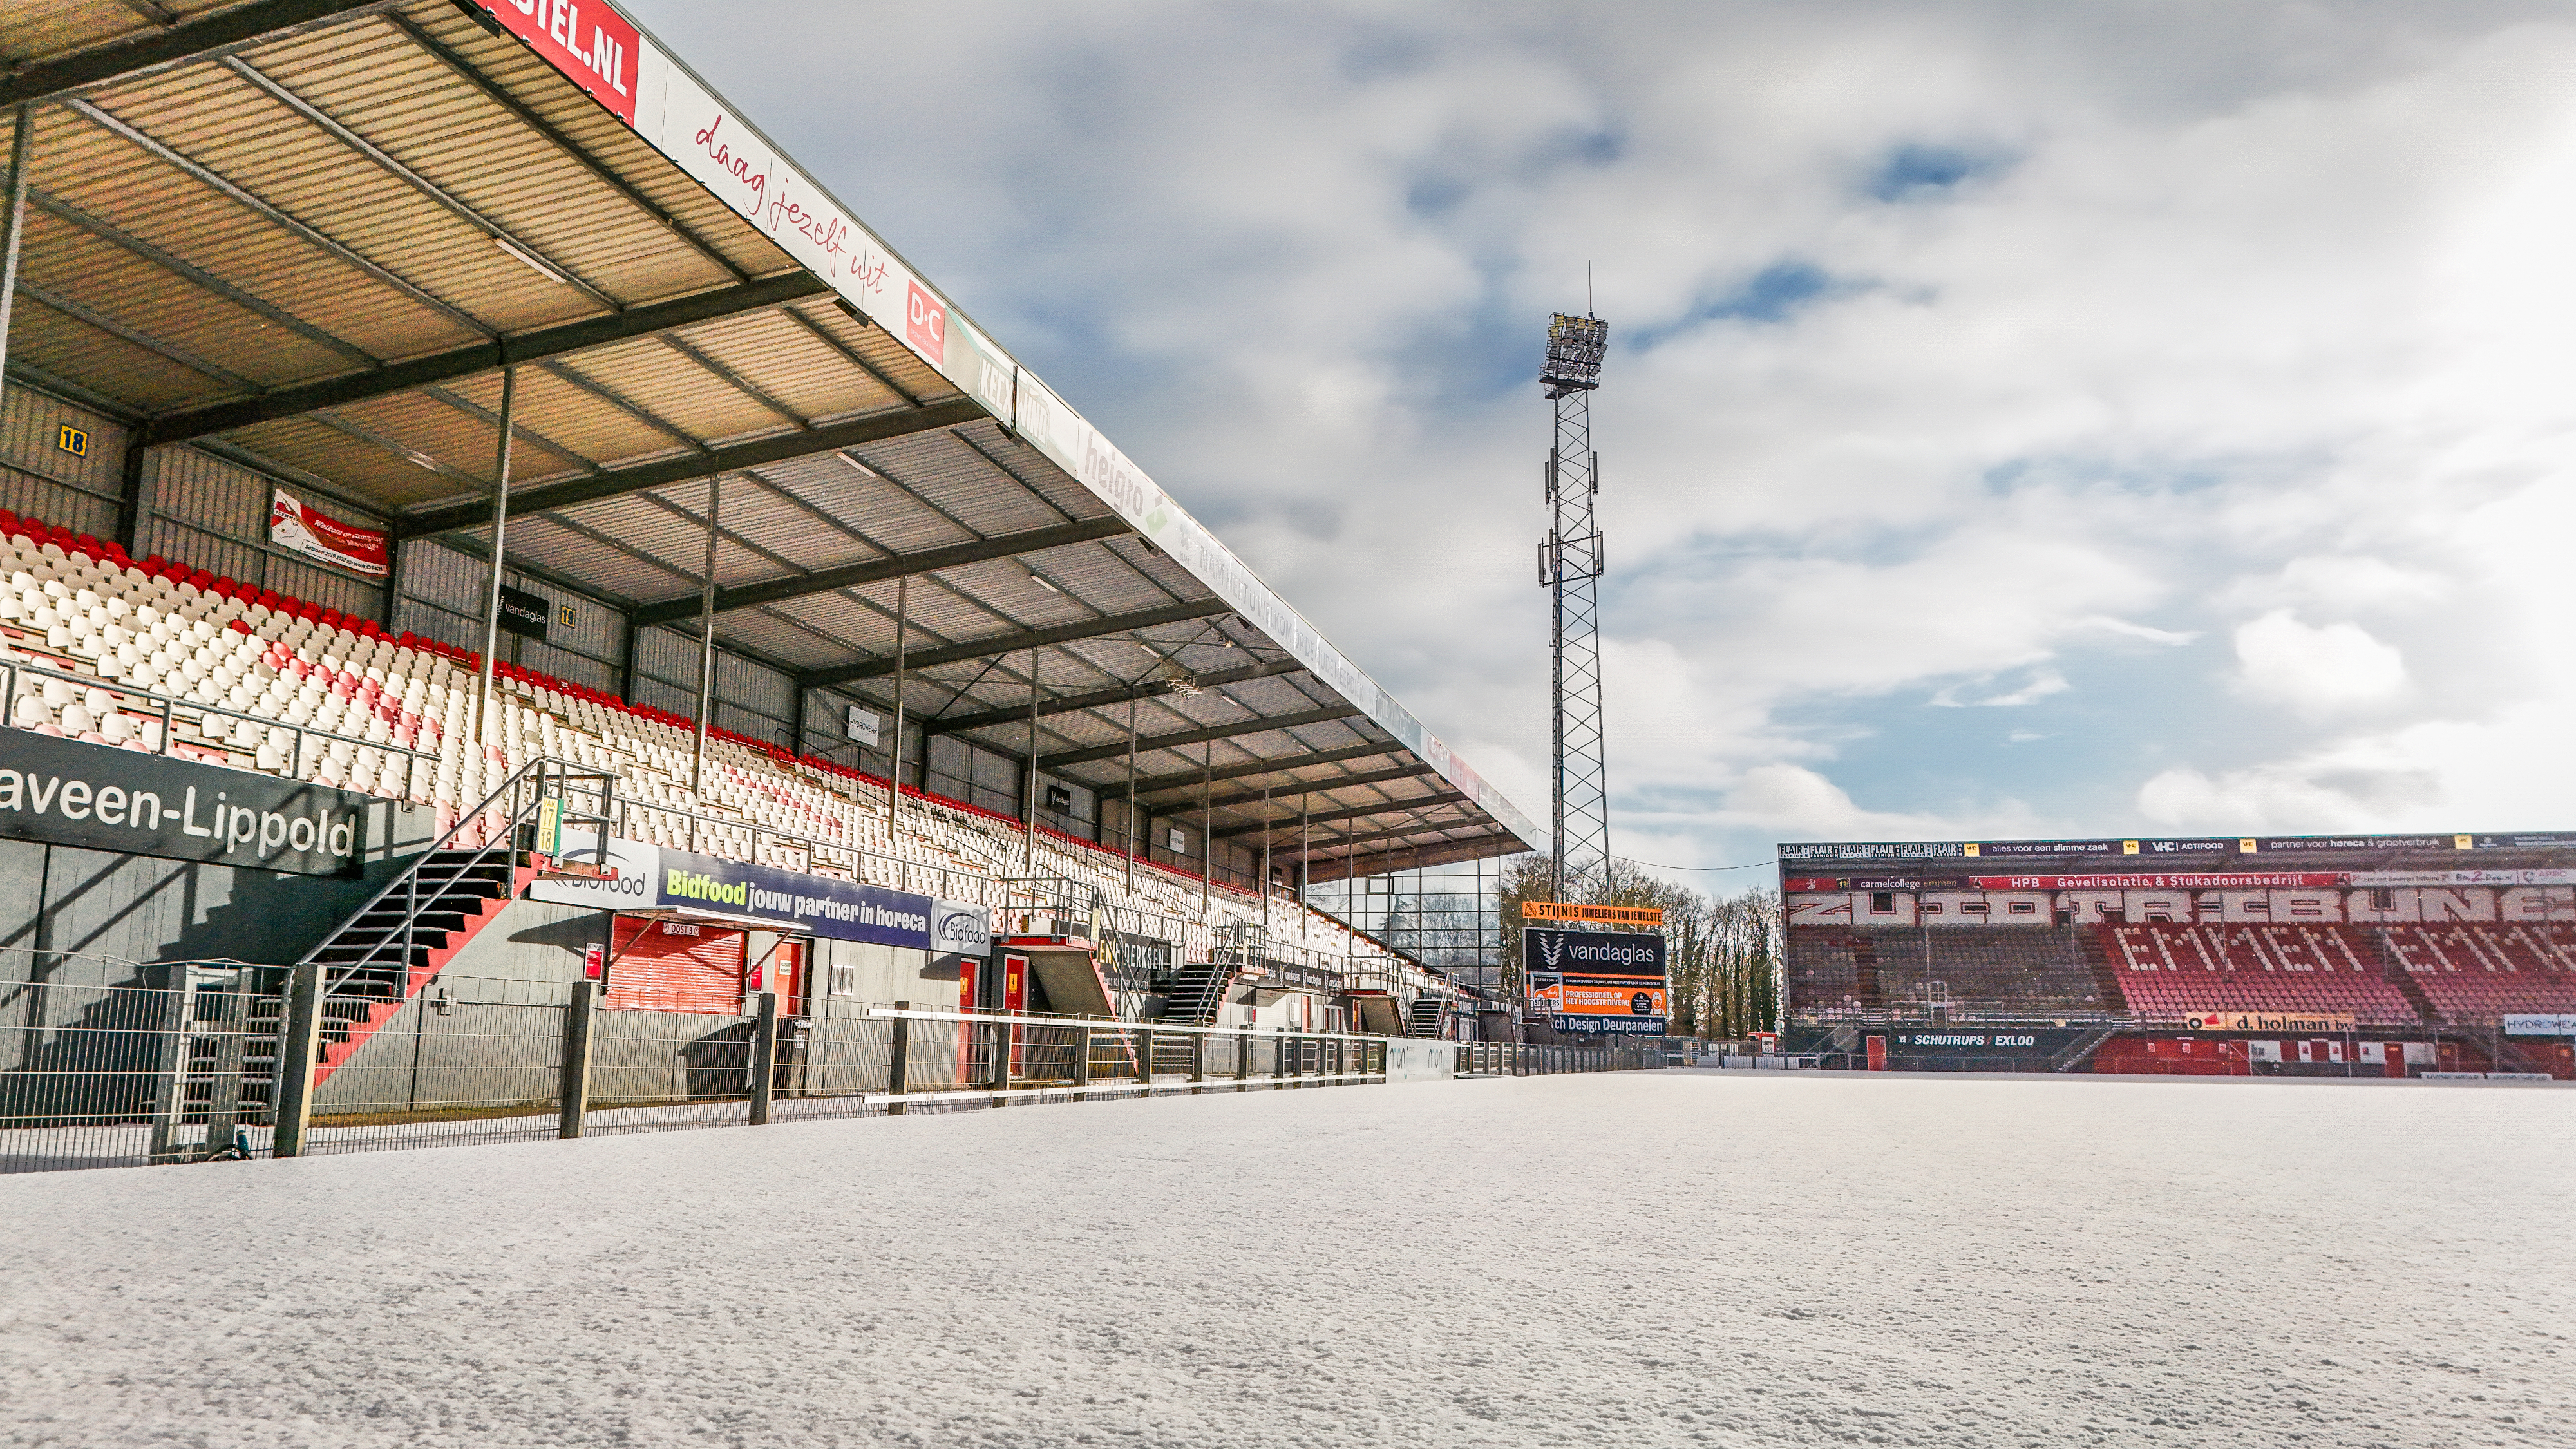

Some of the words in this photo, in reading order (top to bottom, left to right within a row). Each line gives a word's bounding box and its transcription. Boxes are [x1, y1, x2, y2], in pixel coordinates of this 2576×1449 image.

[696, 115, 765, 216] daag
[770, 178, 846, 277] jezelf
[851, 254, 889, 294] uit
[63, 430, 84, 452] 18
[1084, 431, 1144, 517] heigro
[314, 520, 343, 536] Welkom
[505, 603, 546, 625] vandaglas
[562, 609, 574, 625] 19
[543, 799, 556, 808] VAK
[543, 808, 554, 828] 17
[541, 830, 552, 851] 18
[2152, 842, 2175, 851] VHC
[2271, 840, 2304, 849] partner
[2376, 838, 2440, 849] grootverbruik
[1780, 845, 1803, 854] FLAIR
[1810, 845, 1833, 854] FLAIR
[1841, 845, 1863, 854] FLAIR
[1871, 844, 1894, 854] FLAIR
[1902, 844, 1925, 853] FLAIR
[1933, 844, 1956, 853] FLAIR
[1861, 878, 1920, 890] carmelcollege
[2012, 878, 2040, 887] HPB
[2155, 876, 2164, 886] &
[2170, 874, 2303, 887] Stukadoorsbedrijf
[667, 869, 746, 907] Bidfood
[747, 882, 793, 913] jouw
[794, 895, 858, 919] partner
[860, 901, 874, 925] in
[876, 904, 926, 933] horeca
[1539, 904, 1579, 920] STIJNIS
[671, 924, 688, 934] OOST
[689, 926, 693, 934] 3
[950, 922, 986, 945] Bidfood
[1124, 943, 1164, 971] DERKSEN
[1569, 942, 1654, 965] vandaglas
[1568, 1017, 1600, 1033] Design
[1602, 1018, 1663, 1034] Deurpanelen
[2237, 1016, 2253, 1030] d.
[2257, 1015, 2329, 1030] holman
[1914, 1034, 1985, 1045] SCHUTRUPS
[1994, 1036, 2034, 1046] EXLOO
